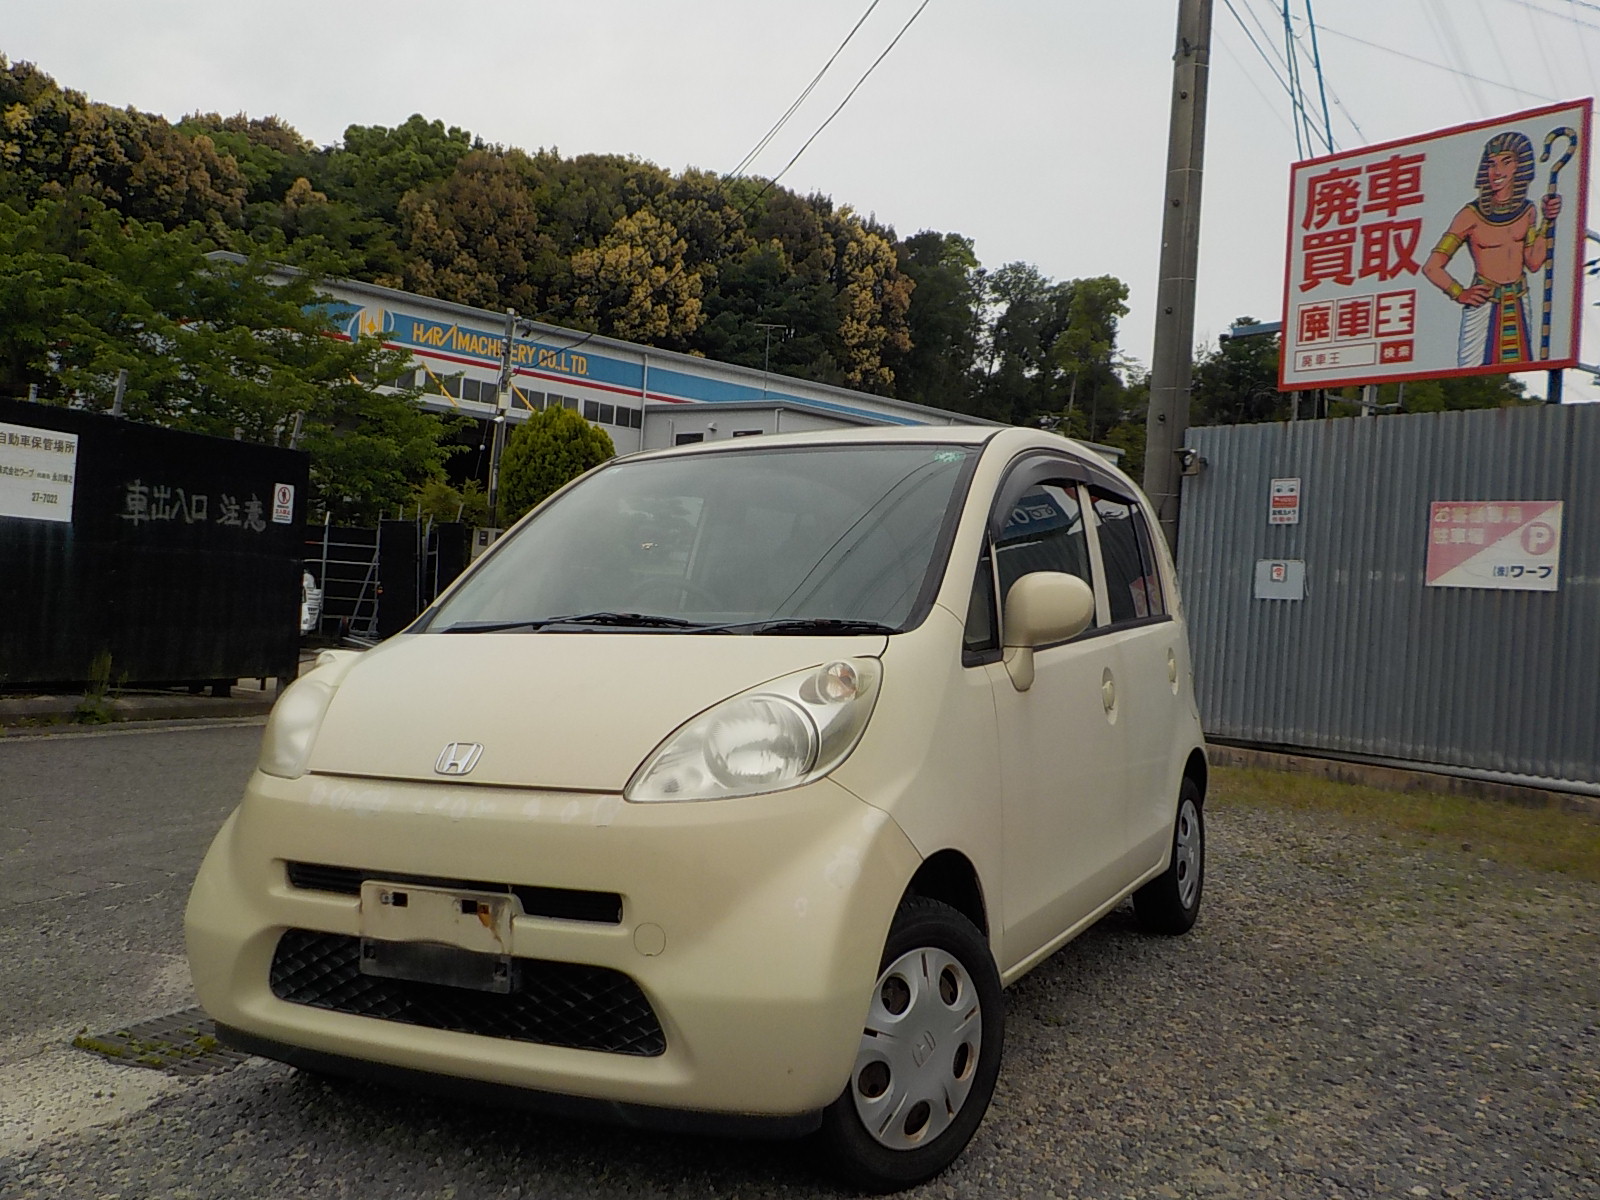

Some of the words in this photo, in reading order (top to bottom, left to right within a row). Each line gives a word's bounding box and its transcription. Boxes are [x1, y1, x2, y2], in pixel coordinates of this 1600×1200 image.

[1301, 153, 1426, 231] 廃車
[1299, 217, 1423, 292] 買取
[1298, 289, 1416, 343] 廃車王
[412, 322, 458, 350] HARA
[457, 333, 538, 365] MACHIERY
[1302, 352, 1340, 367] 廃車王
[31, 492, 58, 504] 27-7022
[120, 479, 208, 526] 車出入口
[216, 493, 267, 532] 注意
[1529, 526, 1551, 552] P
